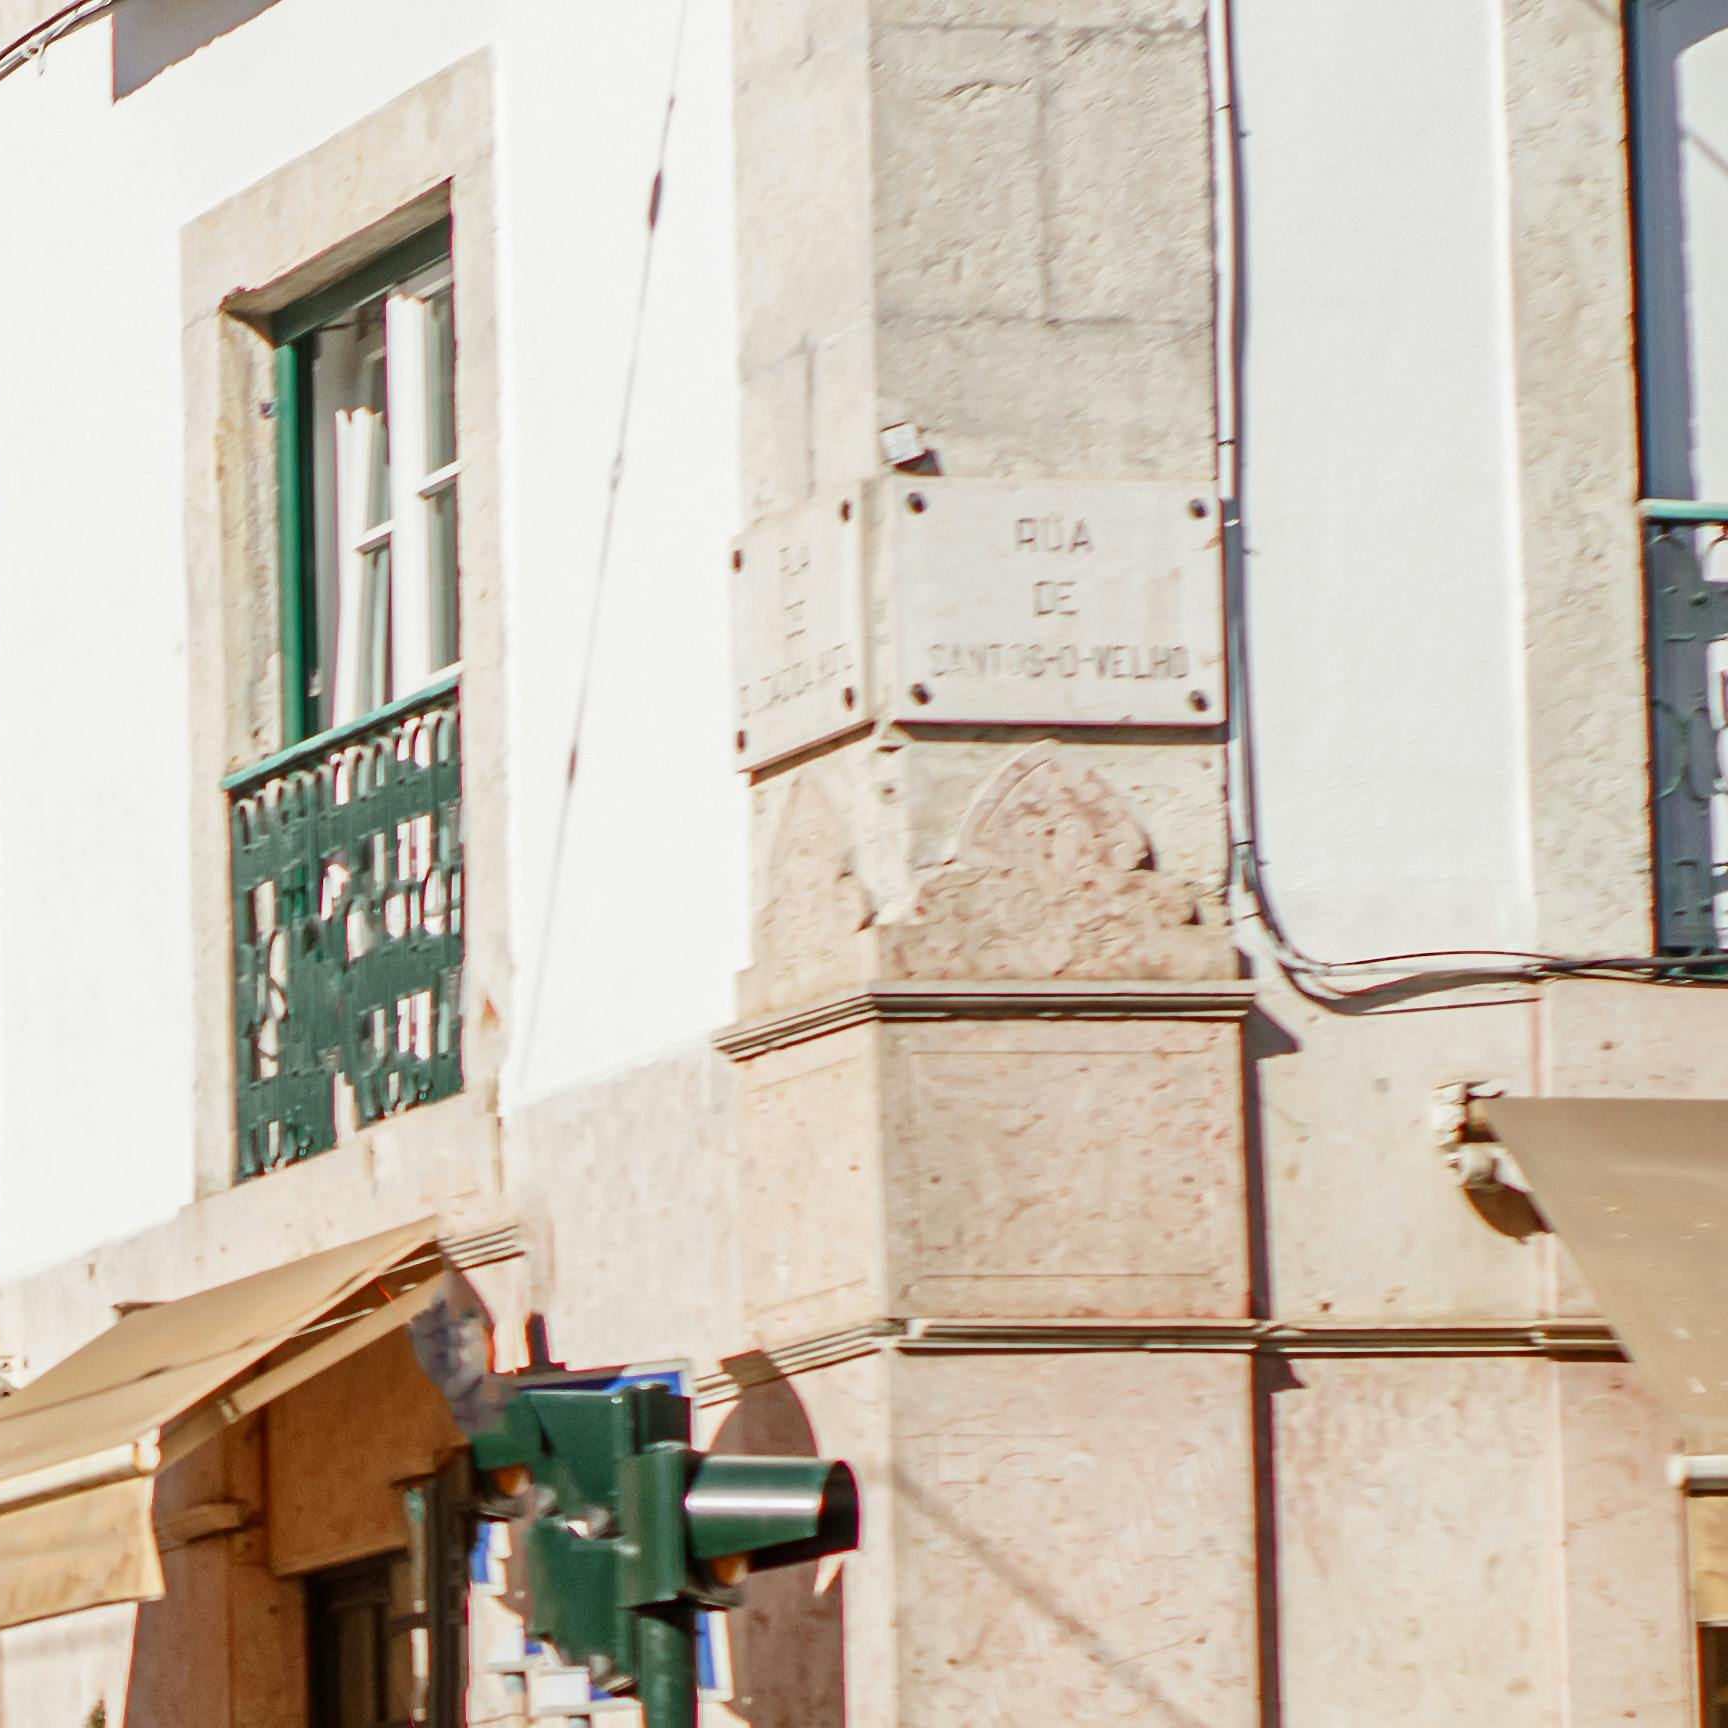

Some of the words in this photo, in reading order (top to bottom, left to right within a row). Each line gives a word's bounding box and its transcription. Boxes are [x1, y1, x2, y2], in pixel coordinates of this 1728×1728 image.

[1015, 516, 1093, 551] RUA
[1033, 581, 1078, 616] DE
[928, 643, 1190, 680] SANTOS-O-VELHO
